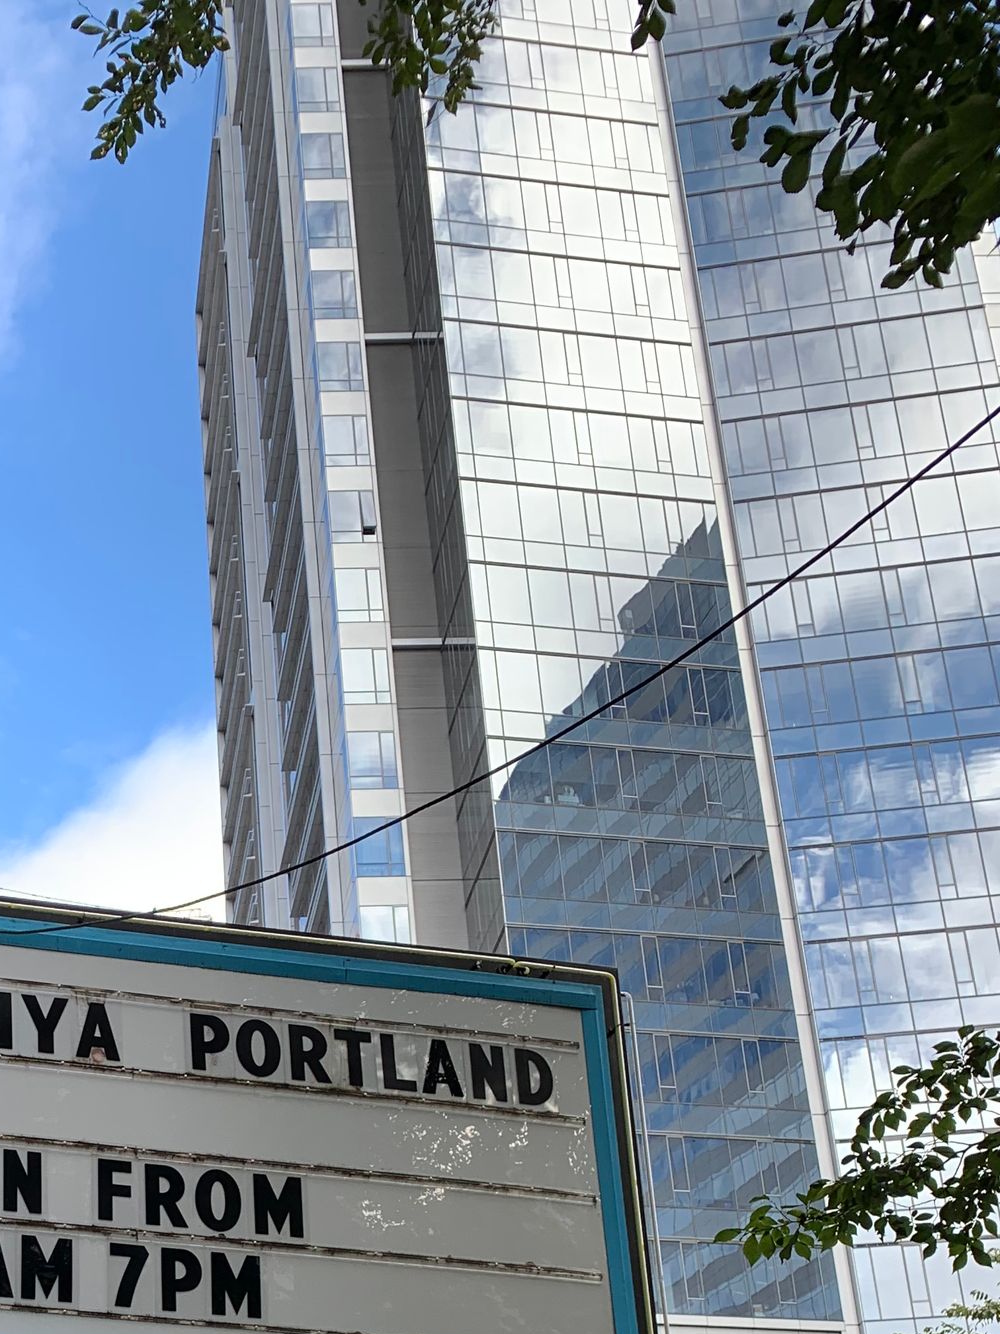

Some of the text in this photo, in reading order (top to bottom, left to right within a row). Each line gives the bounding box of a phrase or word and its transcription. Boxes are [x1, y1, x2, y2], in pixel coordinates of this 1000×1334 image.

[189, 1012, 554, 1106] PORTLAND
[97, 1157, 304, 1239] FROM
[109, 1242, 262, 1319] 7PM
